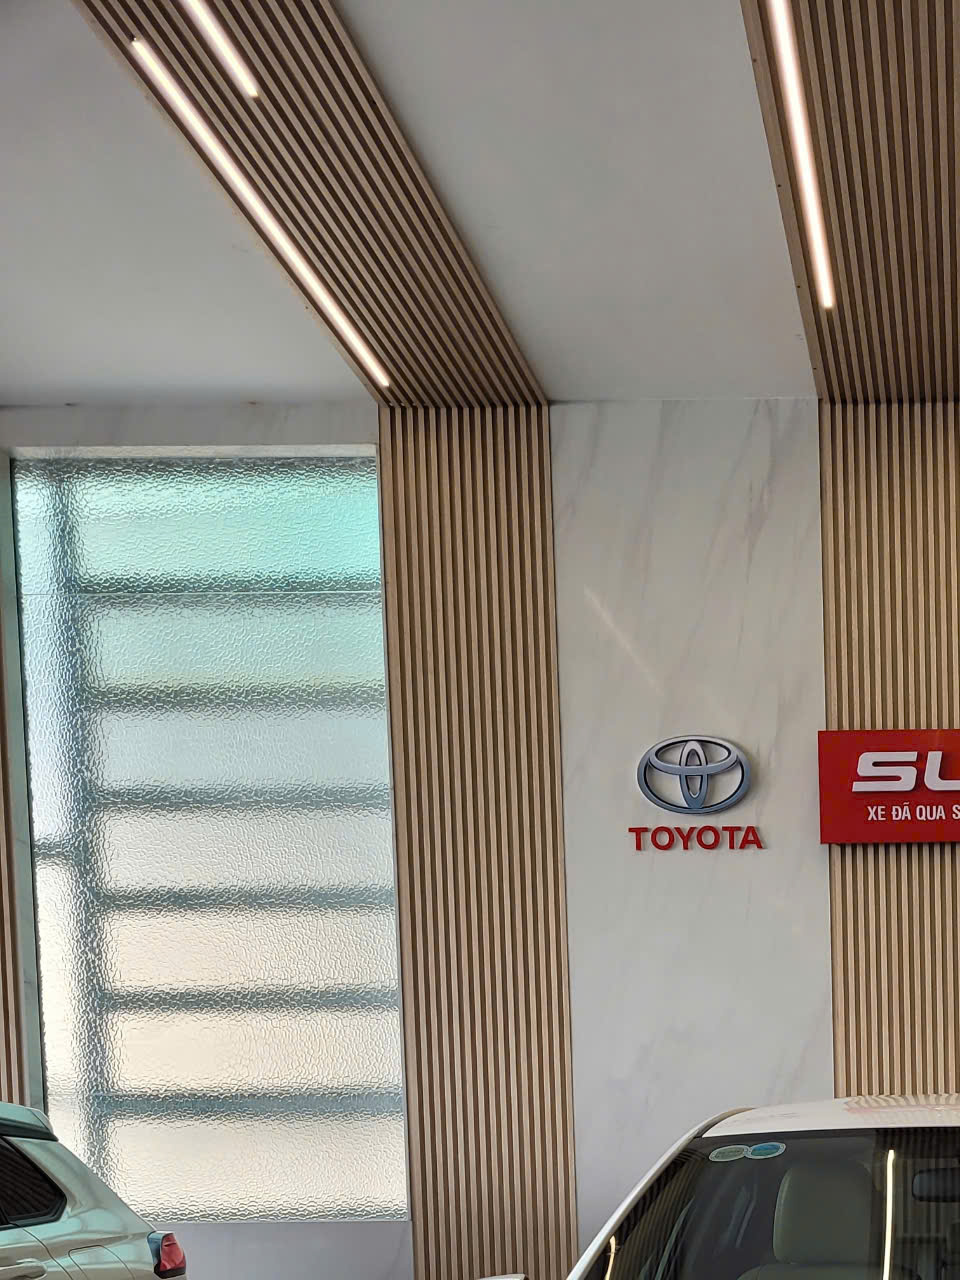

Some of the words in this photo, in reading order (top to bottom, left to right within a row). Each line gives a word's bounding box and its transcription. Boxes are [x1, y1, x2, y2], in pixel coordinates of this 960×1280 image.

[867, 806, 886, 821] XE
[890, 802, 912, 821] ĐÃ
[916, 805, 946, 822] QUA
[628, 825, 763, 851] TOYOTA
